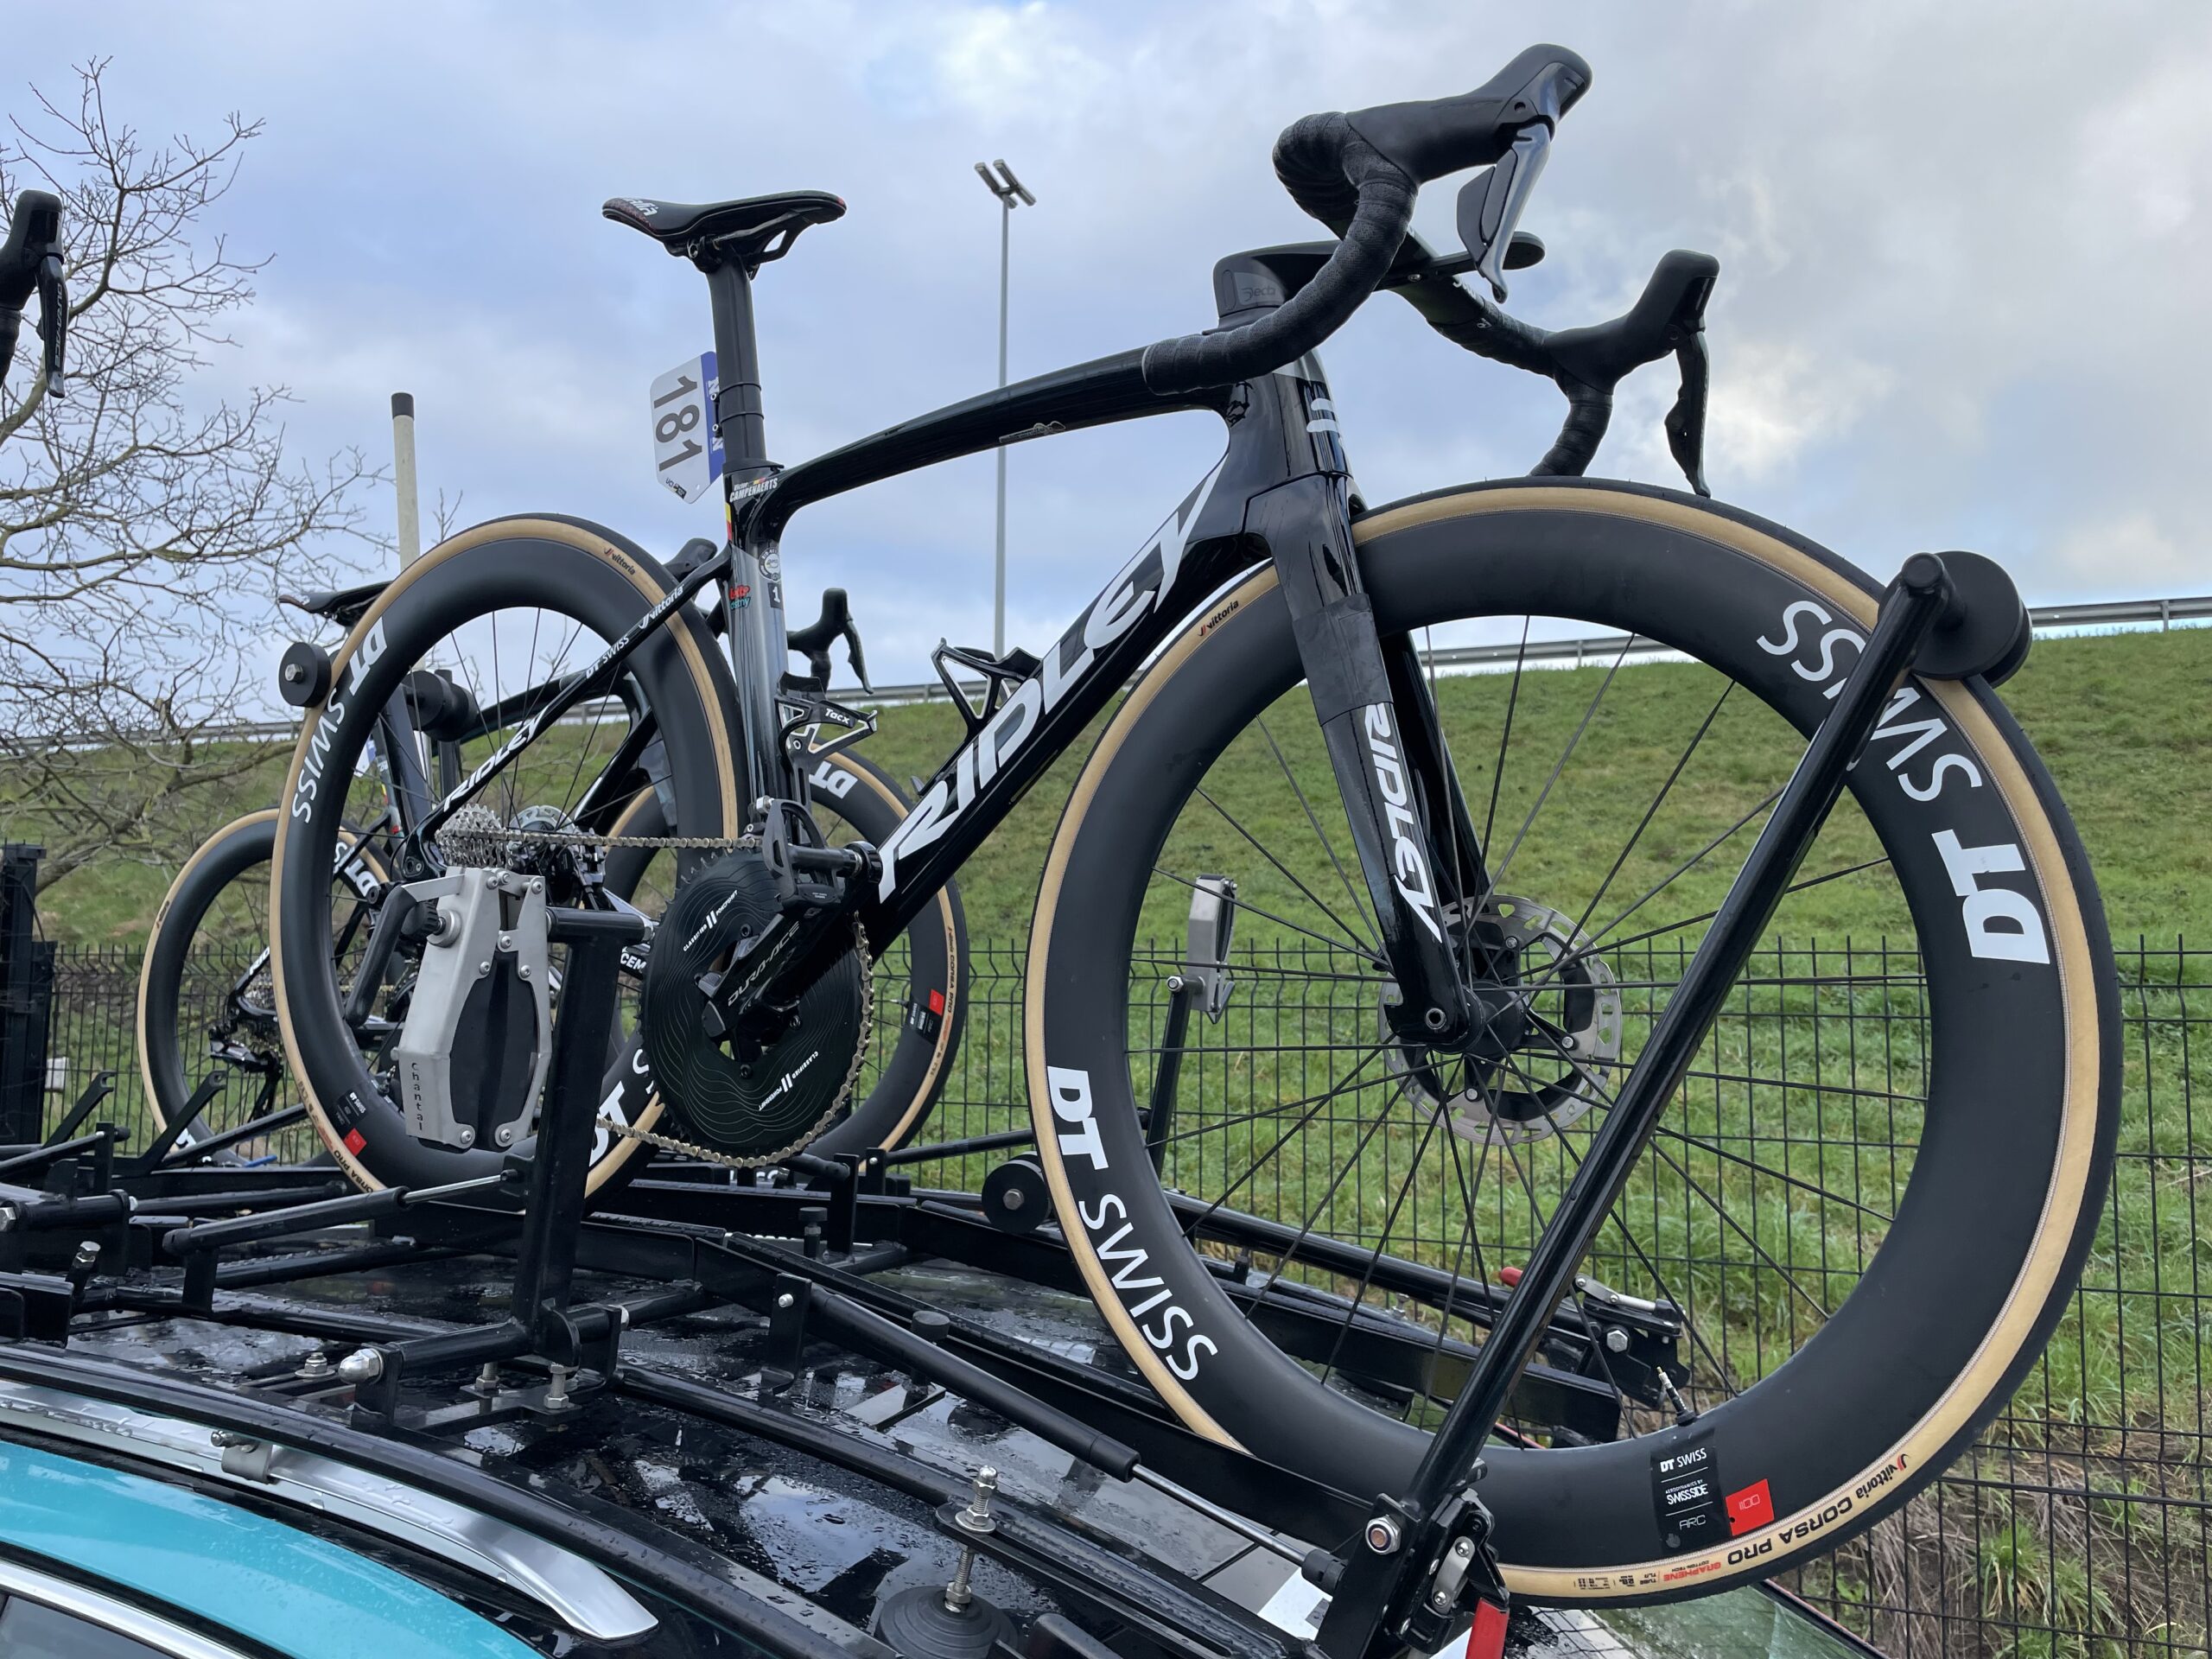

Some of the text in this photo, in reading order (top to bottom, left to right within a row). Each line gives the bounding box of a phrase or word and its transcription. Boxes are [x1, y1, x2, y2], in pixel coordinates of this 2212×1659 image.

[653, 375, 702, 472] 181
[665, 477, 675, 488] UCI
[729, 477, 779, 503] CAMPENAERTS
[1206, 600, 1239, 629] vittoria
[348, 615, 388, 696] DT
[586, 635, 630, 679] DT SWISS
[878, 451, 1229, 904] RIDLEY
[824, 708, 851, 725] Tacx
[291, 687, 346, 823] SWISS
[1363, 702, 1442, 944] RIDLEY
[1931, 829, 2050, 964] DT
[728, 920, 800, 1007] DURA-ACE
[791, 1051, 819, 1079] CLASSIFIED
[410, 1062, 423, 1131] Chantal
[1046, 1065, 1218, 1381] DT SWISS
[1660, 1447, 1707, 1472] DT SWISS
[1665, 1481, 1698, 1494] AERODYNAMICS
[1679, 1514, 1707, 1531] ARC
[1727, 1463, 1898, 1566] vittoria CORSA PRO
[1663, 1561, 1722, 1582] GRAPHENE
